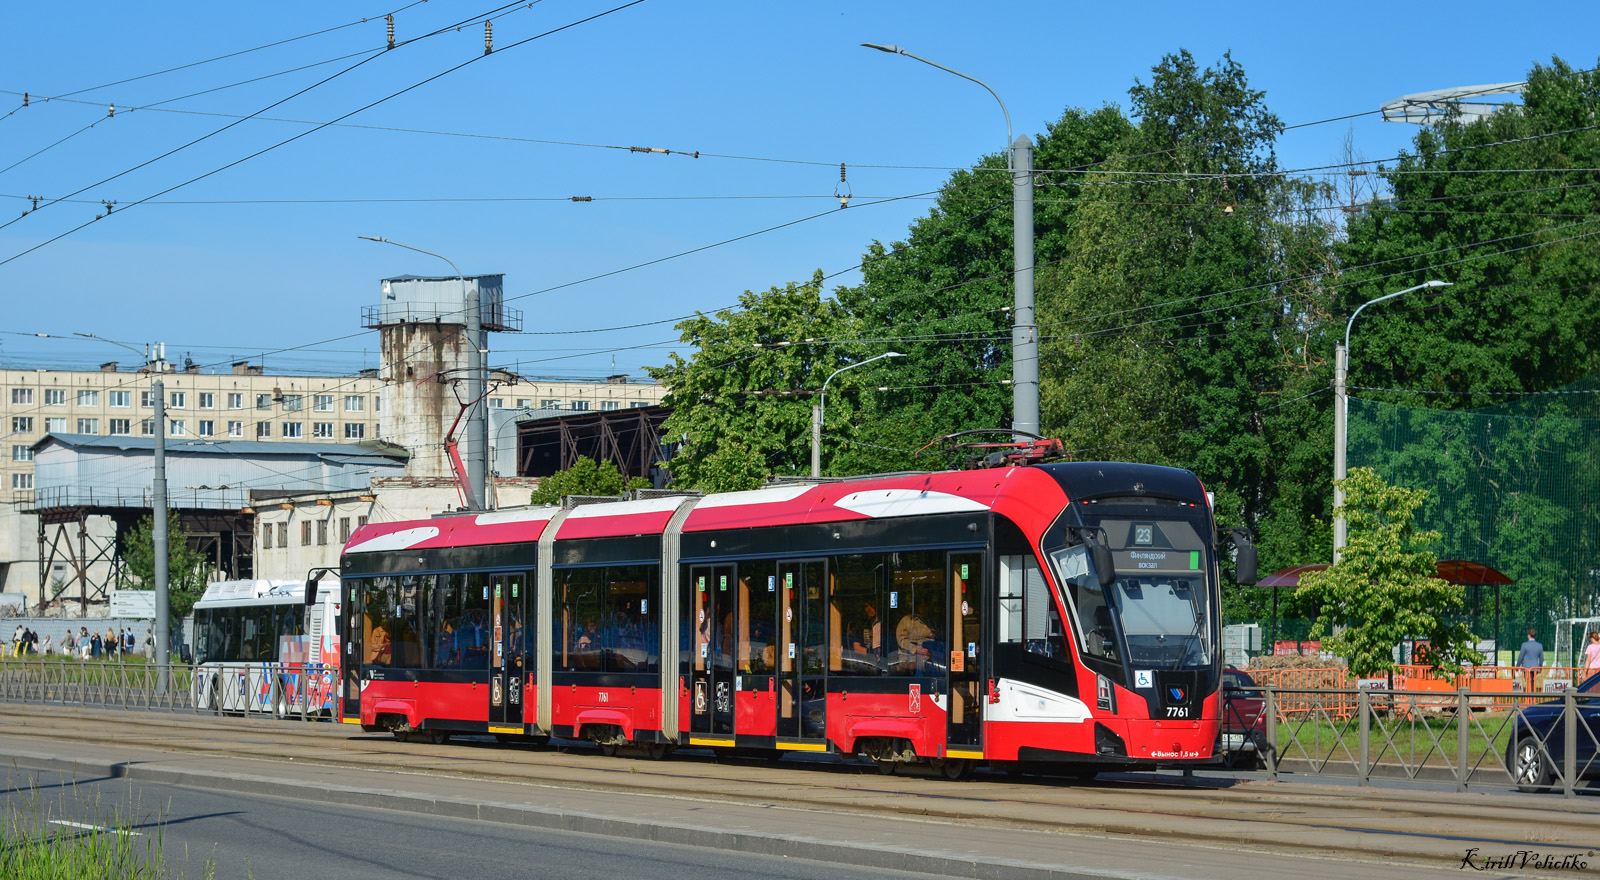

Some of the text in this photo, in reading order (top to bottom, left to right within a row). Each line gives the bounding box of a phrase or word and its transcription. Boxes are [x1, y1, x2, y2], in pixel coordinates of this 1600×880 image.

[1136, 528, 1151, 542] 23
[1130, 551, 1166, 560] Финляндский
[598, 692, 609, 702] 7761
[1166, 707, 1189, 717] 7761
